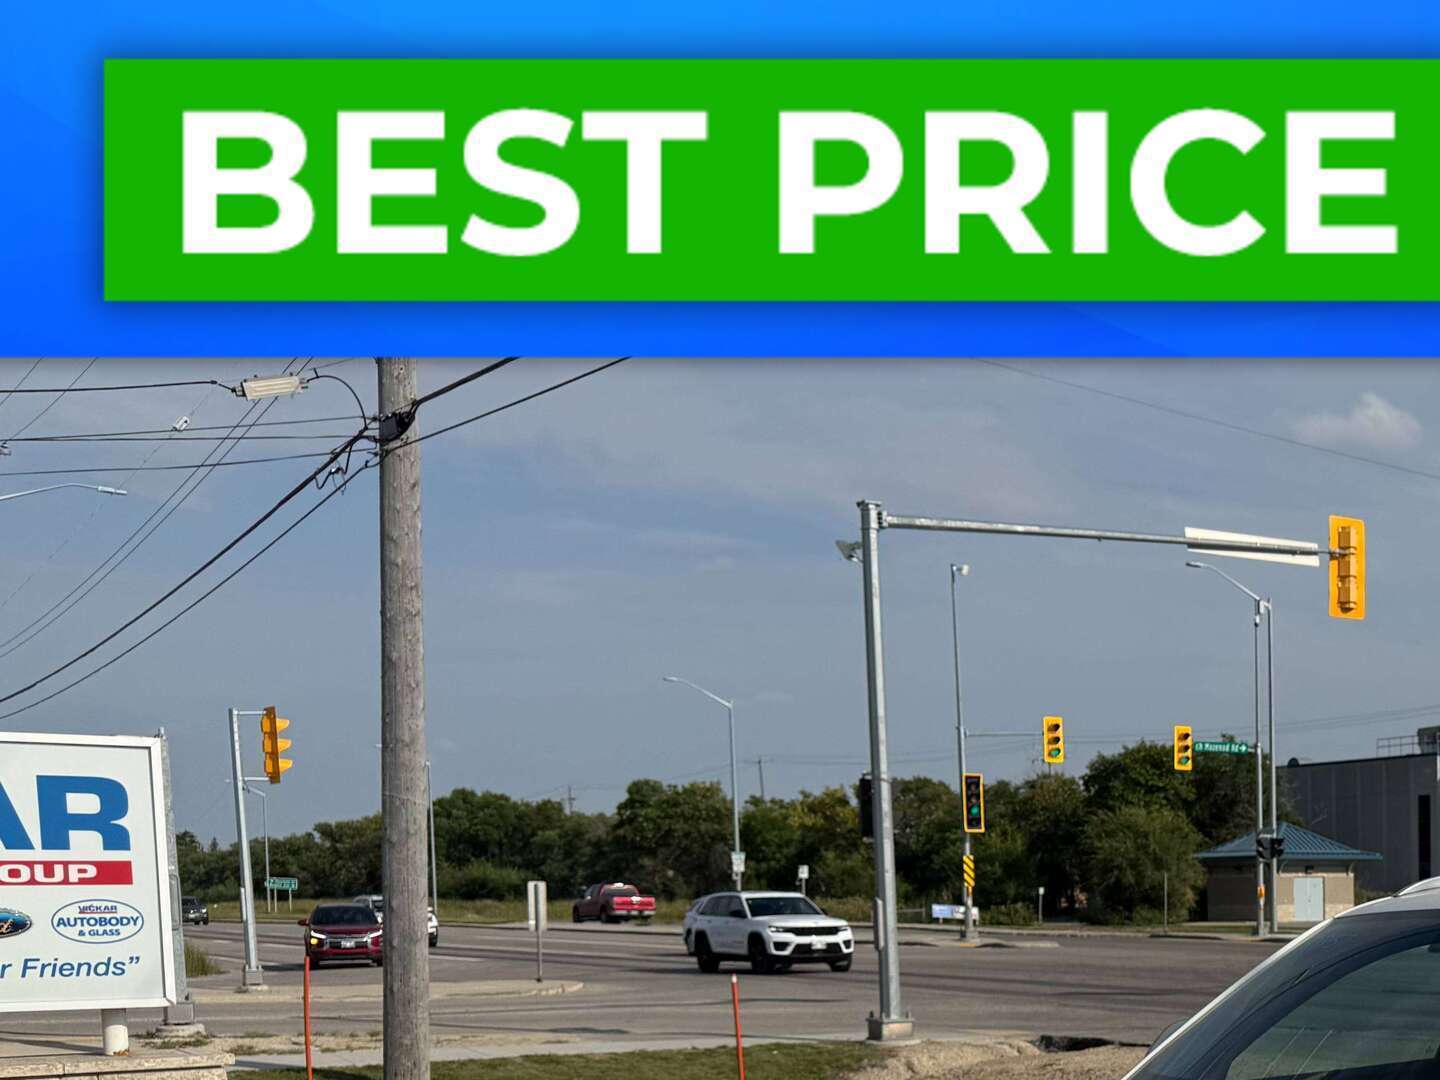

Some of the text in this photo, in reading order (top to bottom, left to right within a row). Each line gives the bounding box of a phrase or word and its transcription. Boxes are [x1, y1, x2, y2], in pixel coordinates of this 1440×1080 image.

[56, 915, 140, 928] AUTOBODY
[78, 928, 121, 937] & GLASS
